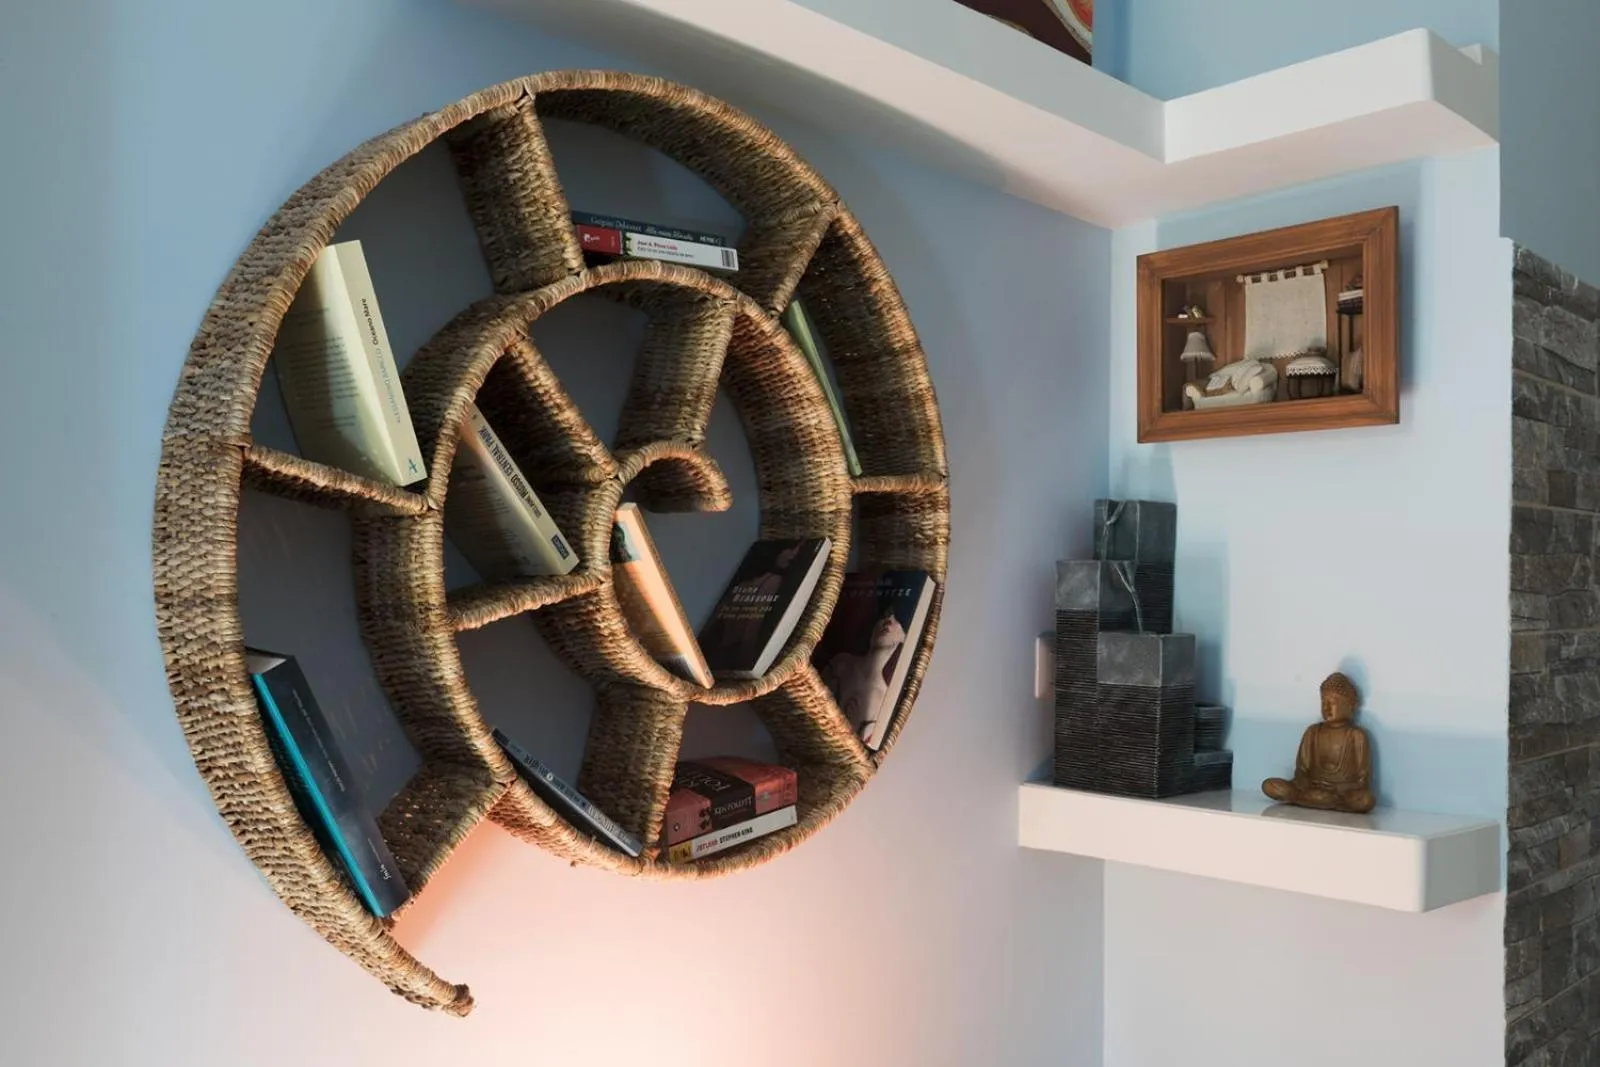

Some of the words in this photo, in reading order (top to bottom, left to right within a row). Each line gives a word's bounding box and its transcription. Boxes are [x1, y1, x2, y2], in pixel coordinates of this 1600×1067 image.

[361, 298, 371, 317] Mare
[366, 317, 378, 346] Oceano
[477, 426, 495, 447] PARK
[490, 445, 513, 476] CENTRAL
[727, 796, 752, 810] FOLLETT
[718, 831, 740, 843] STEPHEN
[741, 826, 753, 835] KING
